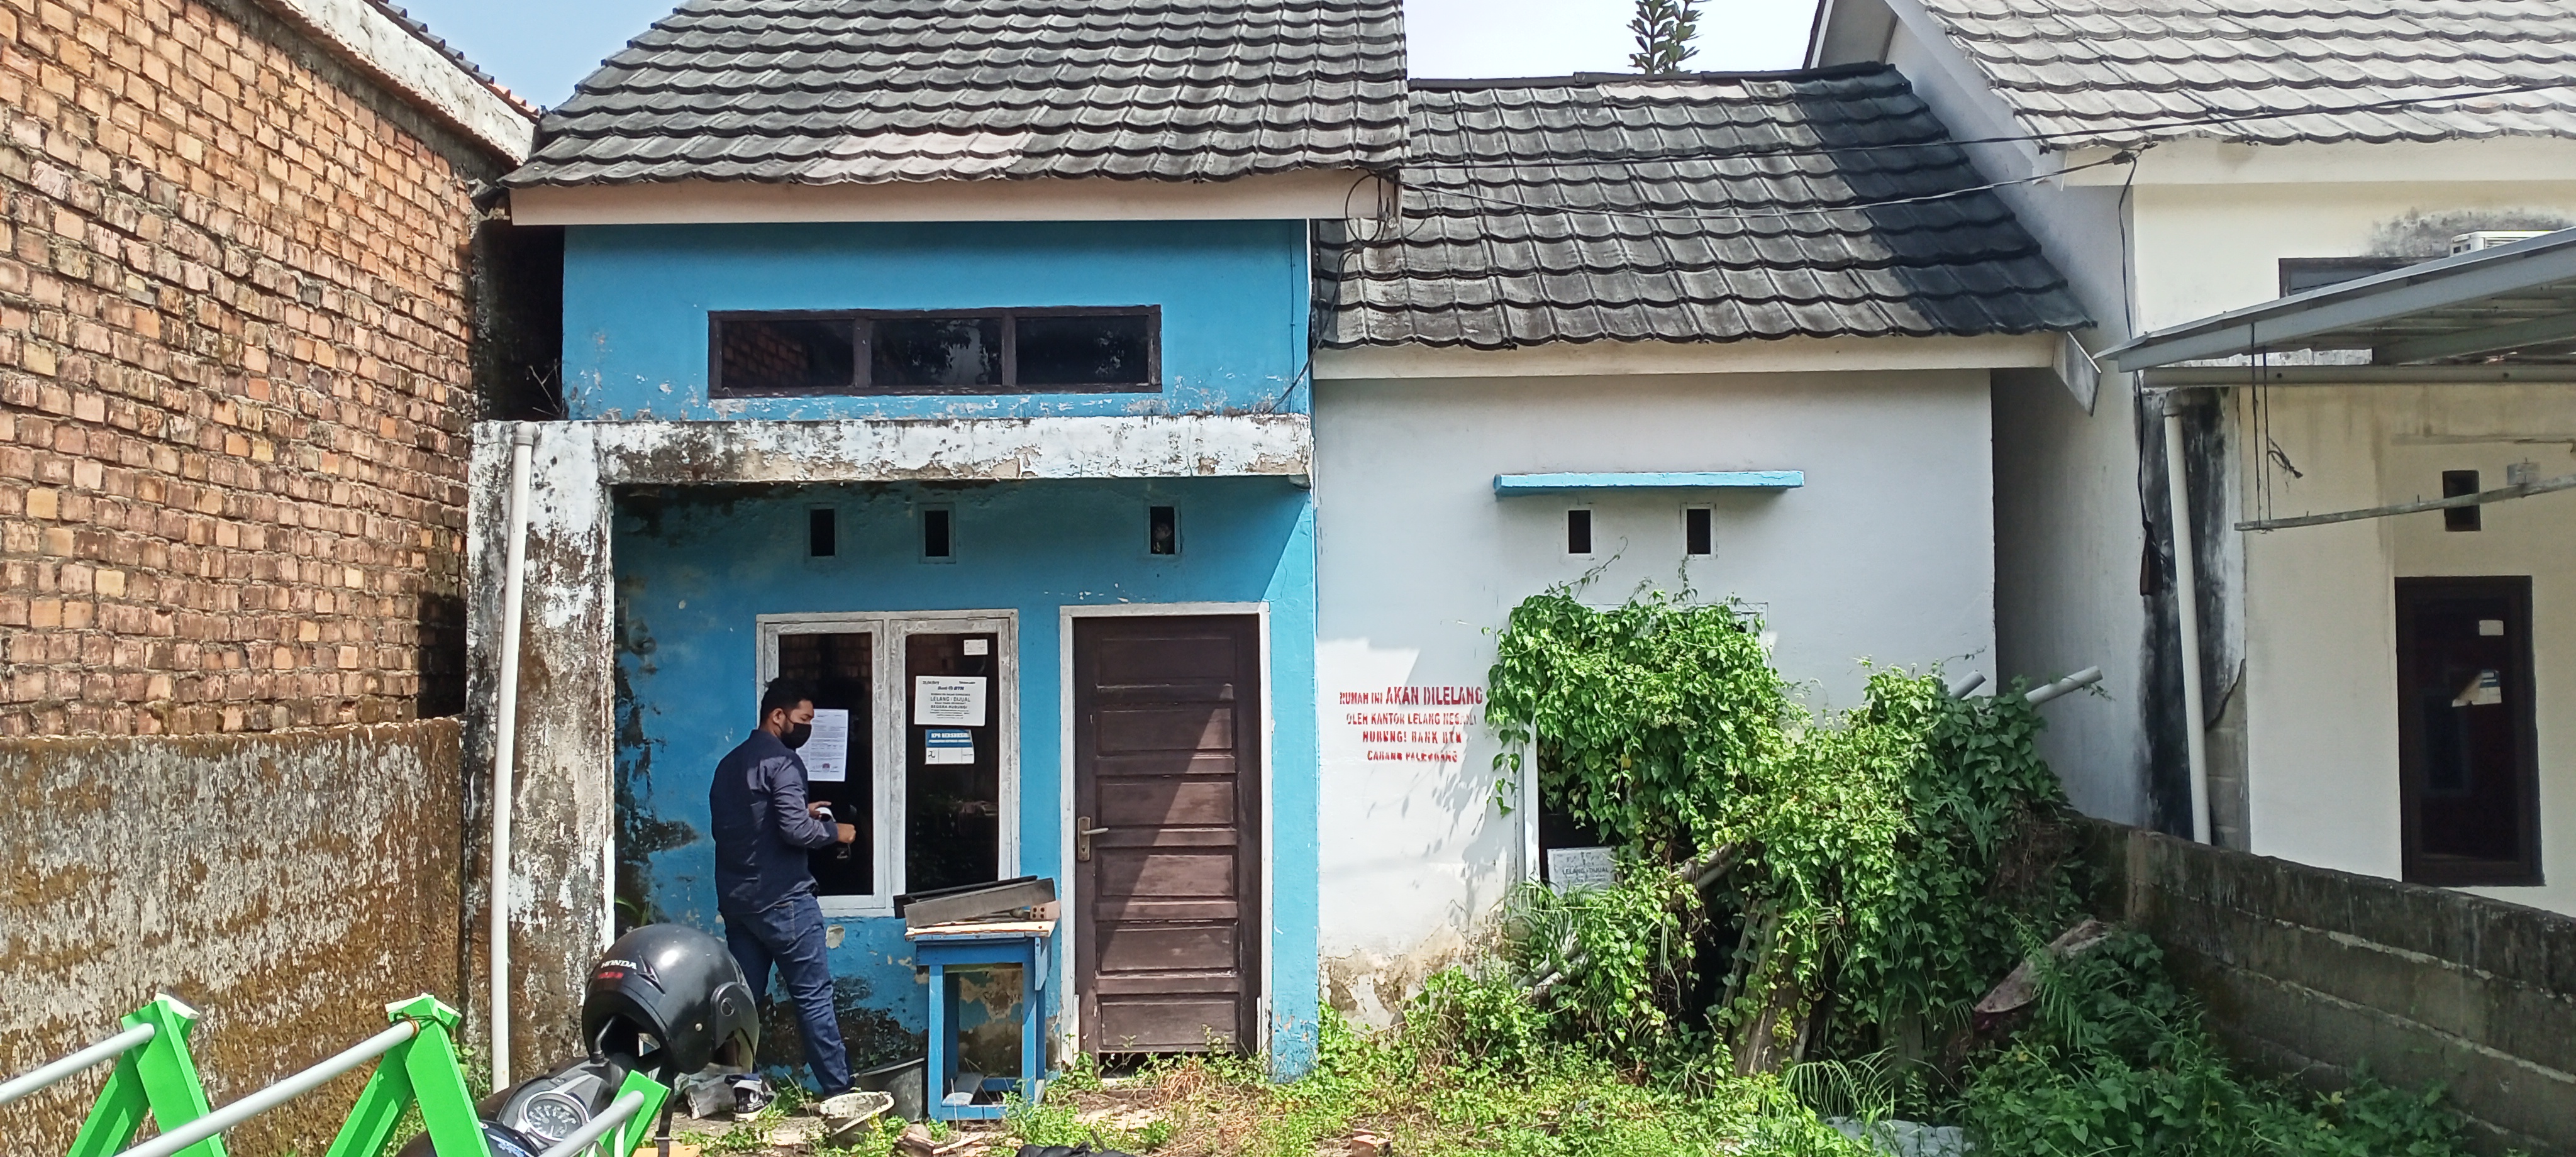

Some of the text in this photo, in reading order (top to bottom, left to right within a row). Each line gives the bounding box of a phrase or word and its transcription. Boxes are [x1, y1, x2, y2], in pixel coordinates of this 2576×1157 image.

[1340, 686, 1483, 705] RUMAH INI AKAN DILELANG
[1346, 712, 1368, 725] OLEH
[1371, 712, 1405, 725] KANTOR
[1407, 712, 1440, 725] LELANG
[1411, 731, 1438, 744] BANK
[600, 960, 638, 970] HONDA
